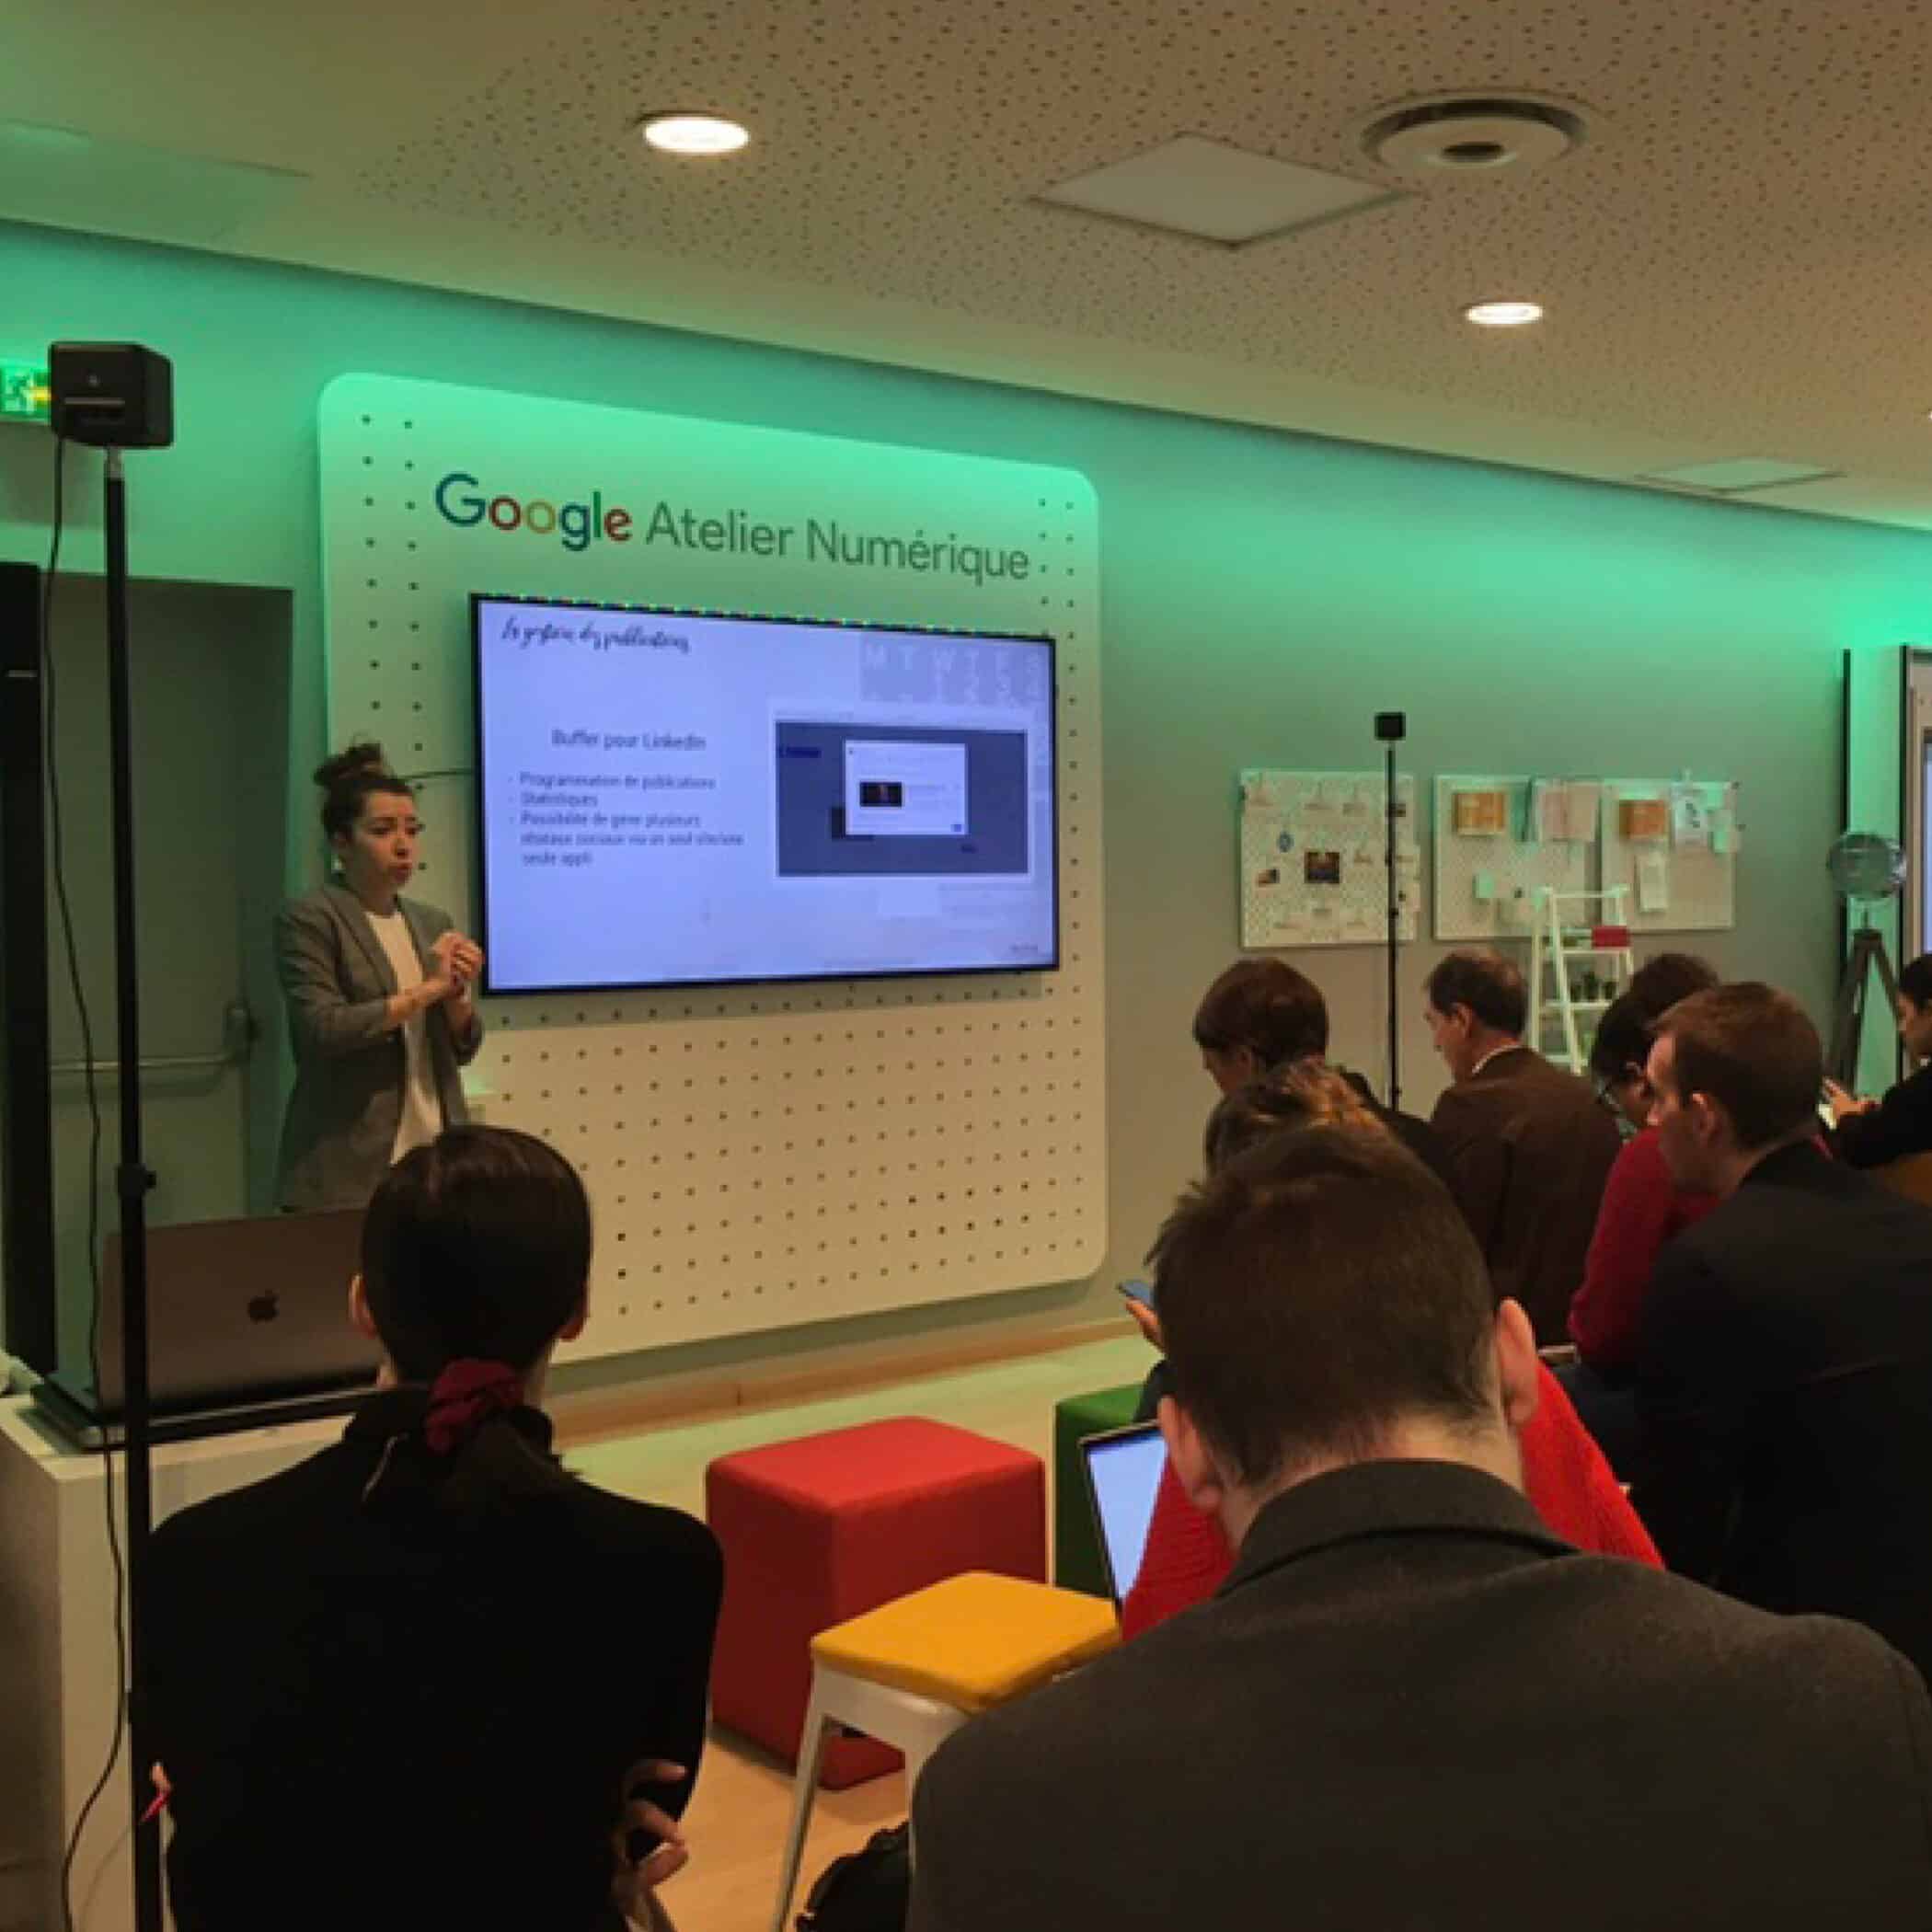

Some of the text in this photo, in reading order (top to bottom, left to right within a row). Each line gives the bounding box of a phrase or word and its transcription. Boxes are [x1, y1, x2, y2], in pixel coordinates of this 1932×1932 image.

[435, 472, 1029, 585] Google Atelier Numérique
[552, 729, 597, 747] Buffer
[604, 732, 640, 752] pour
